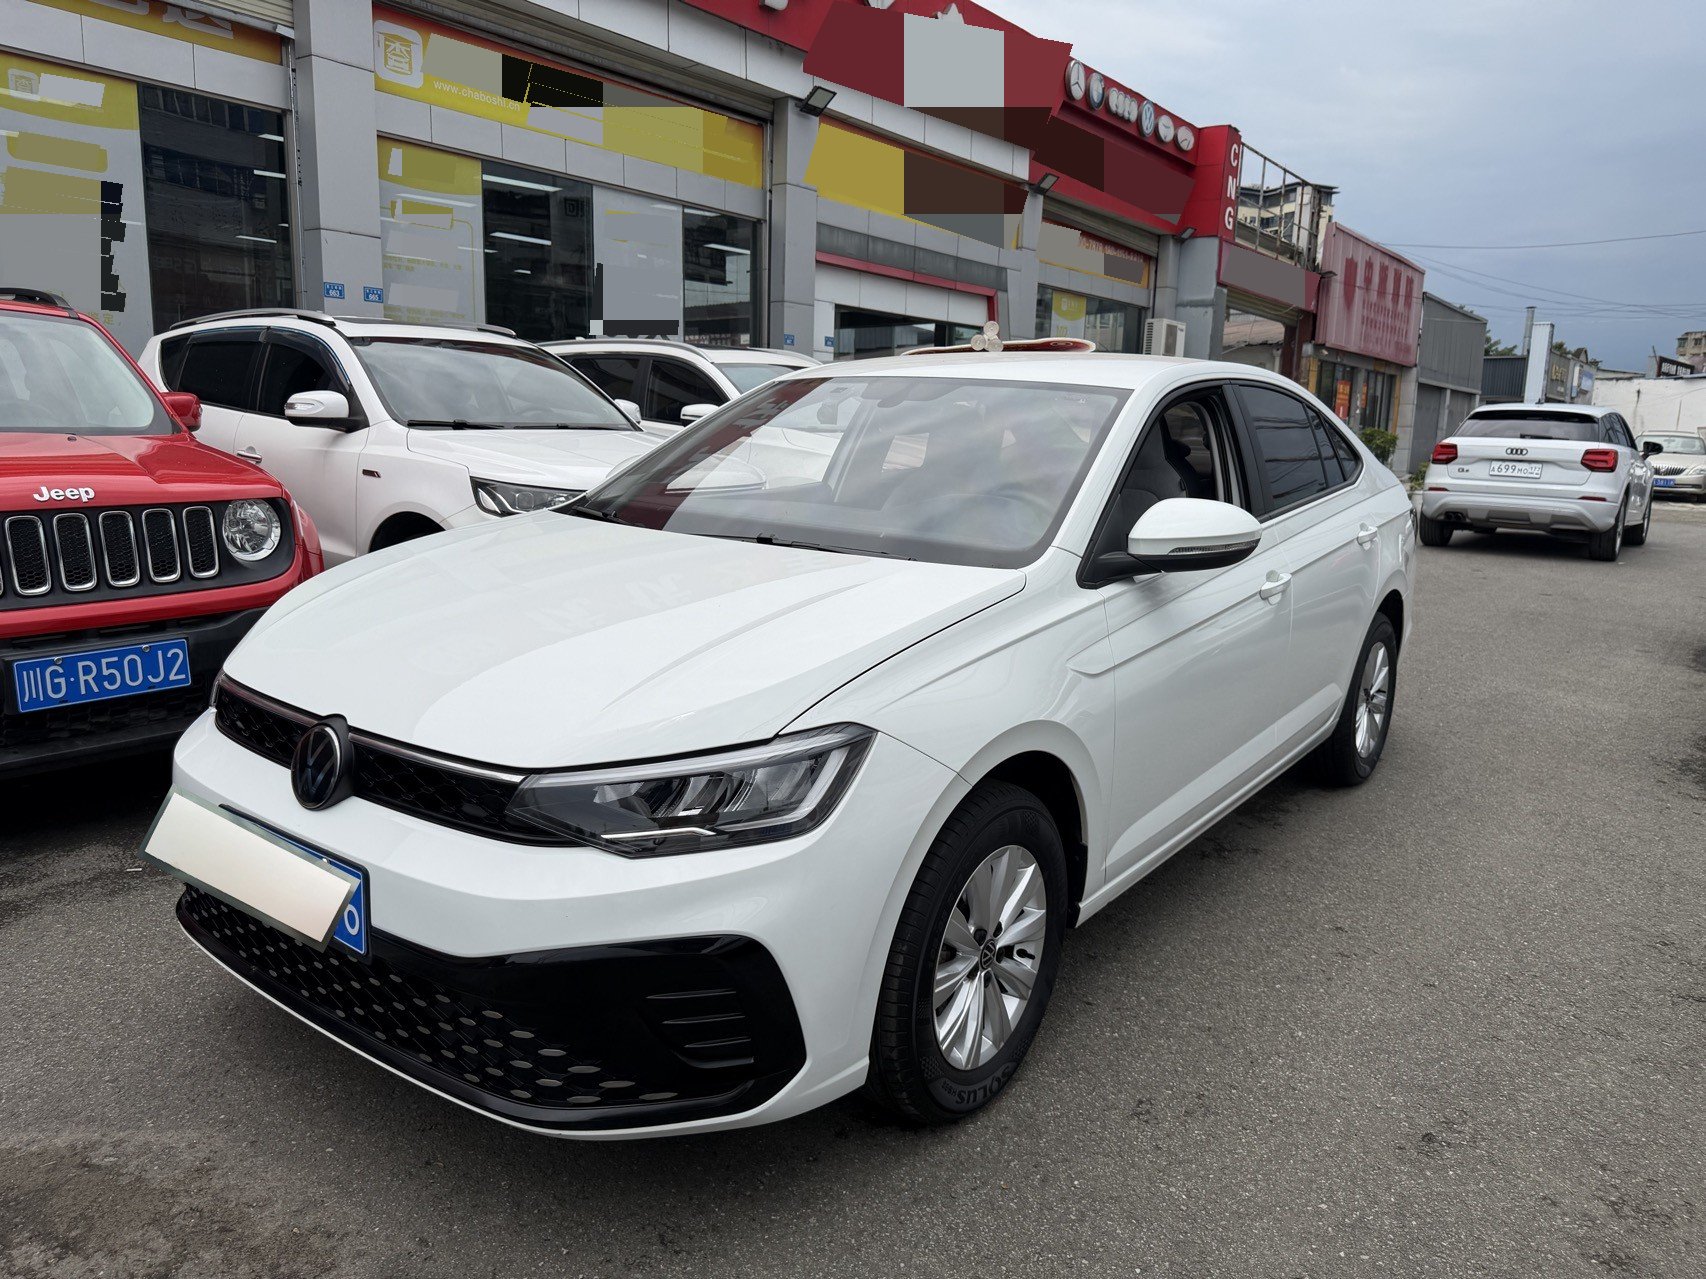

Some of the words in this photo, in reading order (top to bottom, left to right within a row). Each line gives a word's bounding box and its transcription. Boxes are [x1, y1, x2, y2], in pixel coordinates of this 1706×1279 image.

[433, 80, 521, 112] www.chaboshi.cn
[1224, 143, 1239, 230] CNG
[32, 486, 95, 503] Jeep
[23, 649, 187, 703] 川G·R50J2
